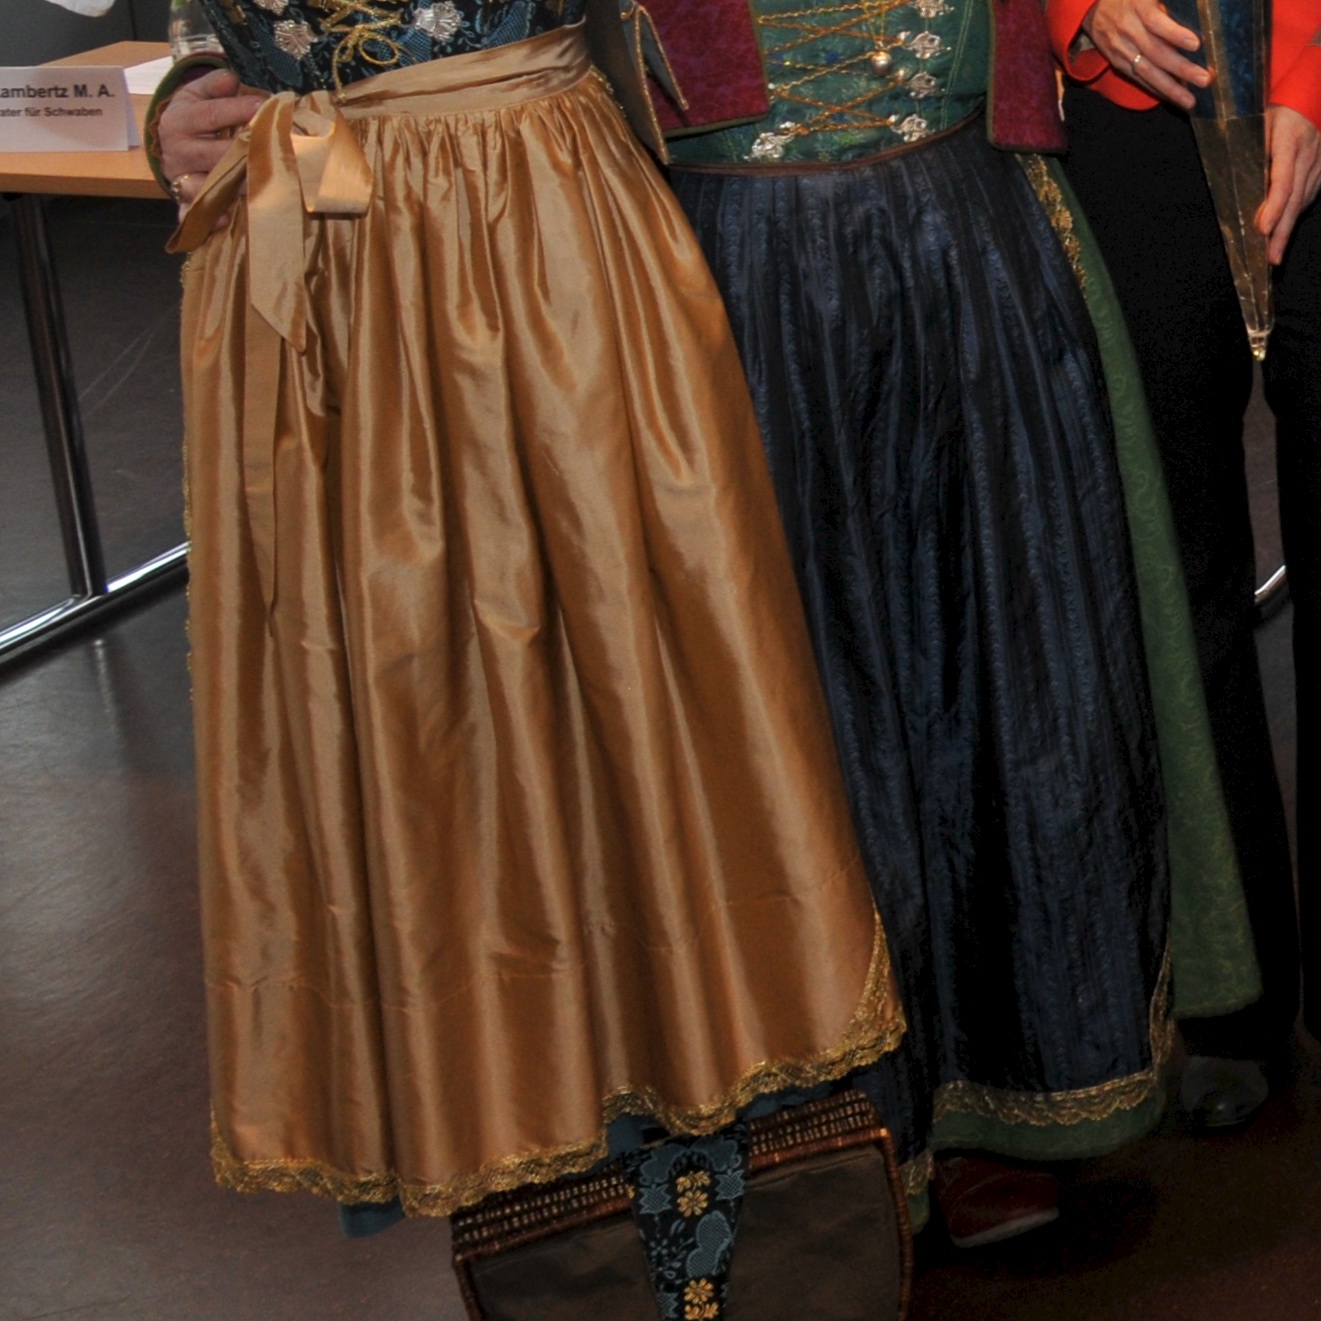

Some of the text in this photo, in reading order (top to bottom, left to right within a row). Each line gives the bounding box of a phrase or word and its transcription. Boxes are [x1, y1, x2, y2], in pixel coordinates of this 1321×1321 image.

[0, 84, 116, 98] ambertz M. A.
[24, 106, 41, 118] für
[44, 106, 103, 118] Schwaben
